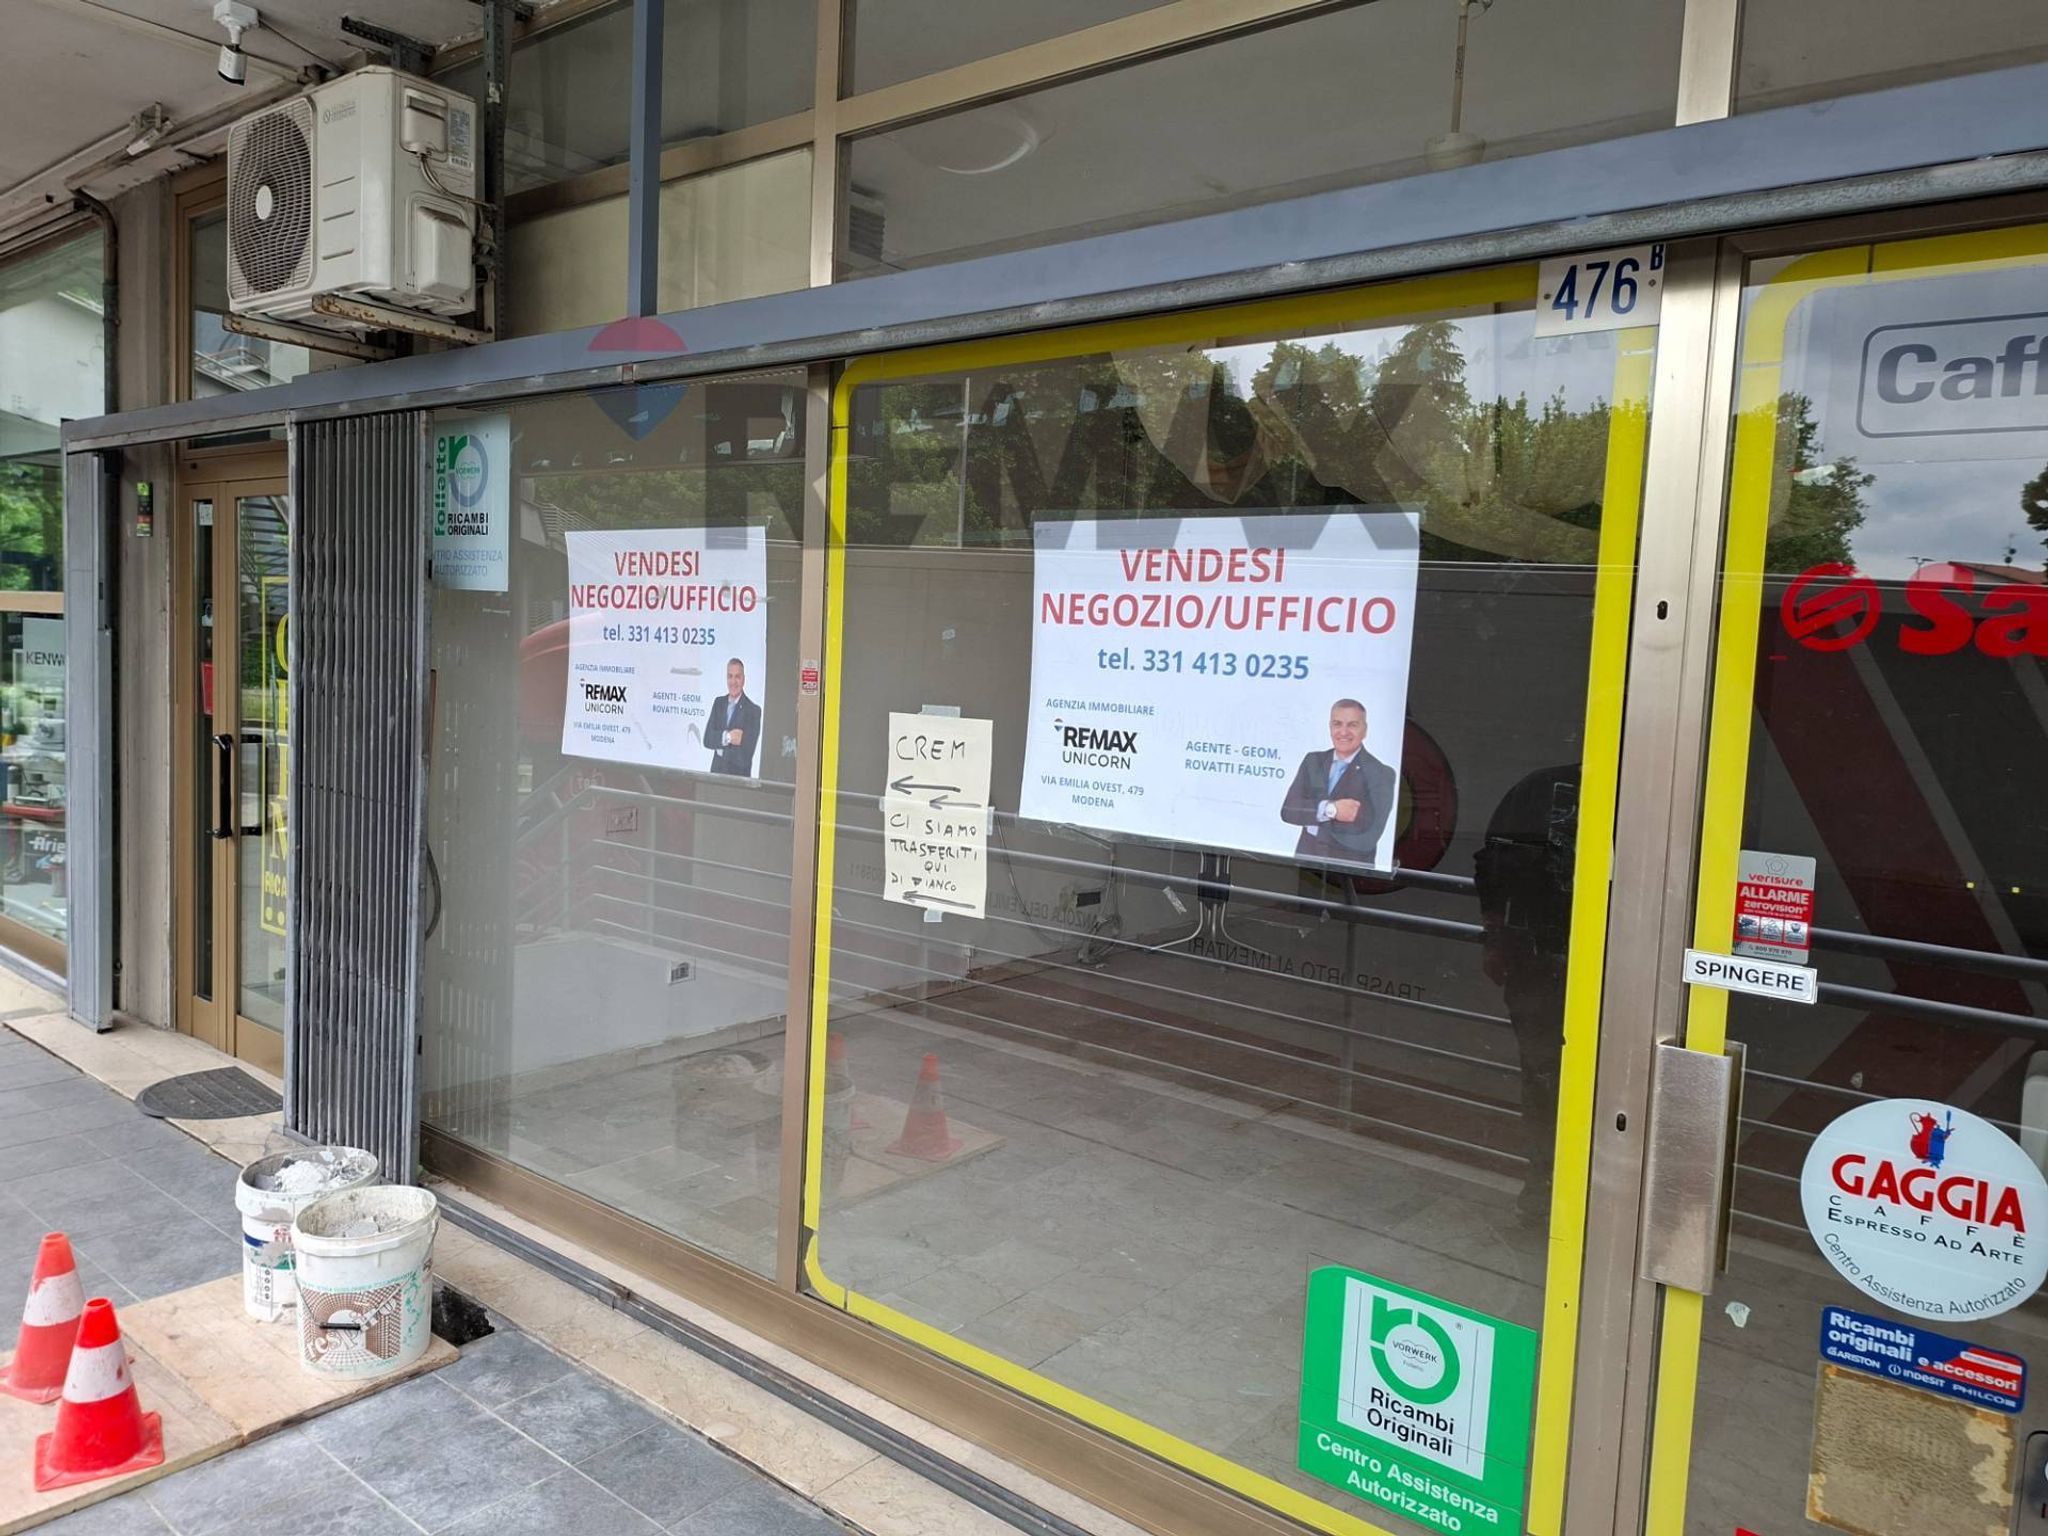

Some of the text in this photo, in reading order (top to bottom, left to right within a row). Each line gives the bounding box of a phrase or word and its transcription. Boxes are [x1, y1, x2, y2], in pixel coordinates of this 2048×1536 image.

[1650, 244, 1664, 270] B
[1552, 257, 1639, 320] 476
[447, 512, 489, 524] RICAMBI
[447, 525, 489, 536] ORIGINALI
[453, 550, 503, 561] ASSISTENZA
[615, 551, 699, 576] VENDESI
[1120, 547, 1286, 583] VENDESI
[434, 565, 488, 576] AUTORIZZATO
[571, 585, 756, 612] NEGOZIO/UFFICIO
[1041, 593, 1397, 634] NEGOZIO/UFFICIO
[603, 624, 716, 645] tel. 331 413 0235
[575, 663, 635, 675] AGENZIA IMMOBILIARE
[1098, 647, 1309, 680] tel. 331 413 0235
[652, 692, 678, 701] AGENTE
[1046, 698, 1154, 716] AGENZIA IMMOBILIARE
[584, 702, 624, 714] UNICORN
[652, 705, 705, 717] ROVATTI FAUSTO
[583, 722, 600, 731] EMILIA
[590, 735, 615, 744] MODENA
[896, 735, 965, 761] CREM
[1062, 751, 1131, 770] UNICORN
[1186, 741, 1231, 755] AGENTE
[1241, 746, 1281, 760] GEOM.
[1185, 759, 1285, 779] ROVATTI FAUSTO
[1041, 775, 1144, 796] VIA EMILIA OVEST, 479
[1072, 795, 1114, 808] MODENA
[890, 813, 977, 838] CI SIAMO
[890, 838, 977, 860] TRASFERITI
[924, 860, 947, 873] QUI
[891, 872, 902, 883] DI
[1749, 873, 1803, 887] verisure
[1740, 886, 1810, 905] ALLARME
[1694, 960, 1805, 991] SPINGERE
[1832, 1154, 2026, 1233] GAGGIA
[1824, 1232, 2026, 1314] Centro Assistenza Autorizzato
[1830, 1312, 1915, 1347] Ricambi
[1392, 1340, 1437, 1363] VORWERK
[1828, 1330, 1912, 1363] originali
[1918, 1357, 1929, 1367] e
[1933, 1360, 2017, 1391] accessori
[1837, 1351, 1881, 1369] ARISTON
[1952, 1383, 2005, 1404] PHILCO
[1371, 1387, 1454, 1434] Ricambi
[1367, 1408, 1453, 1457] Originali
[1317, 1433, 1499, 1524] Centro Assistenza
[1347, 1470, 1461, 1532] Autorizzato
